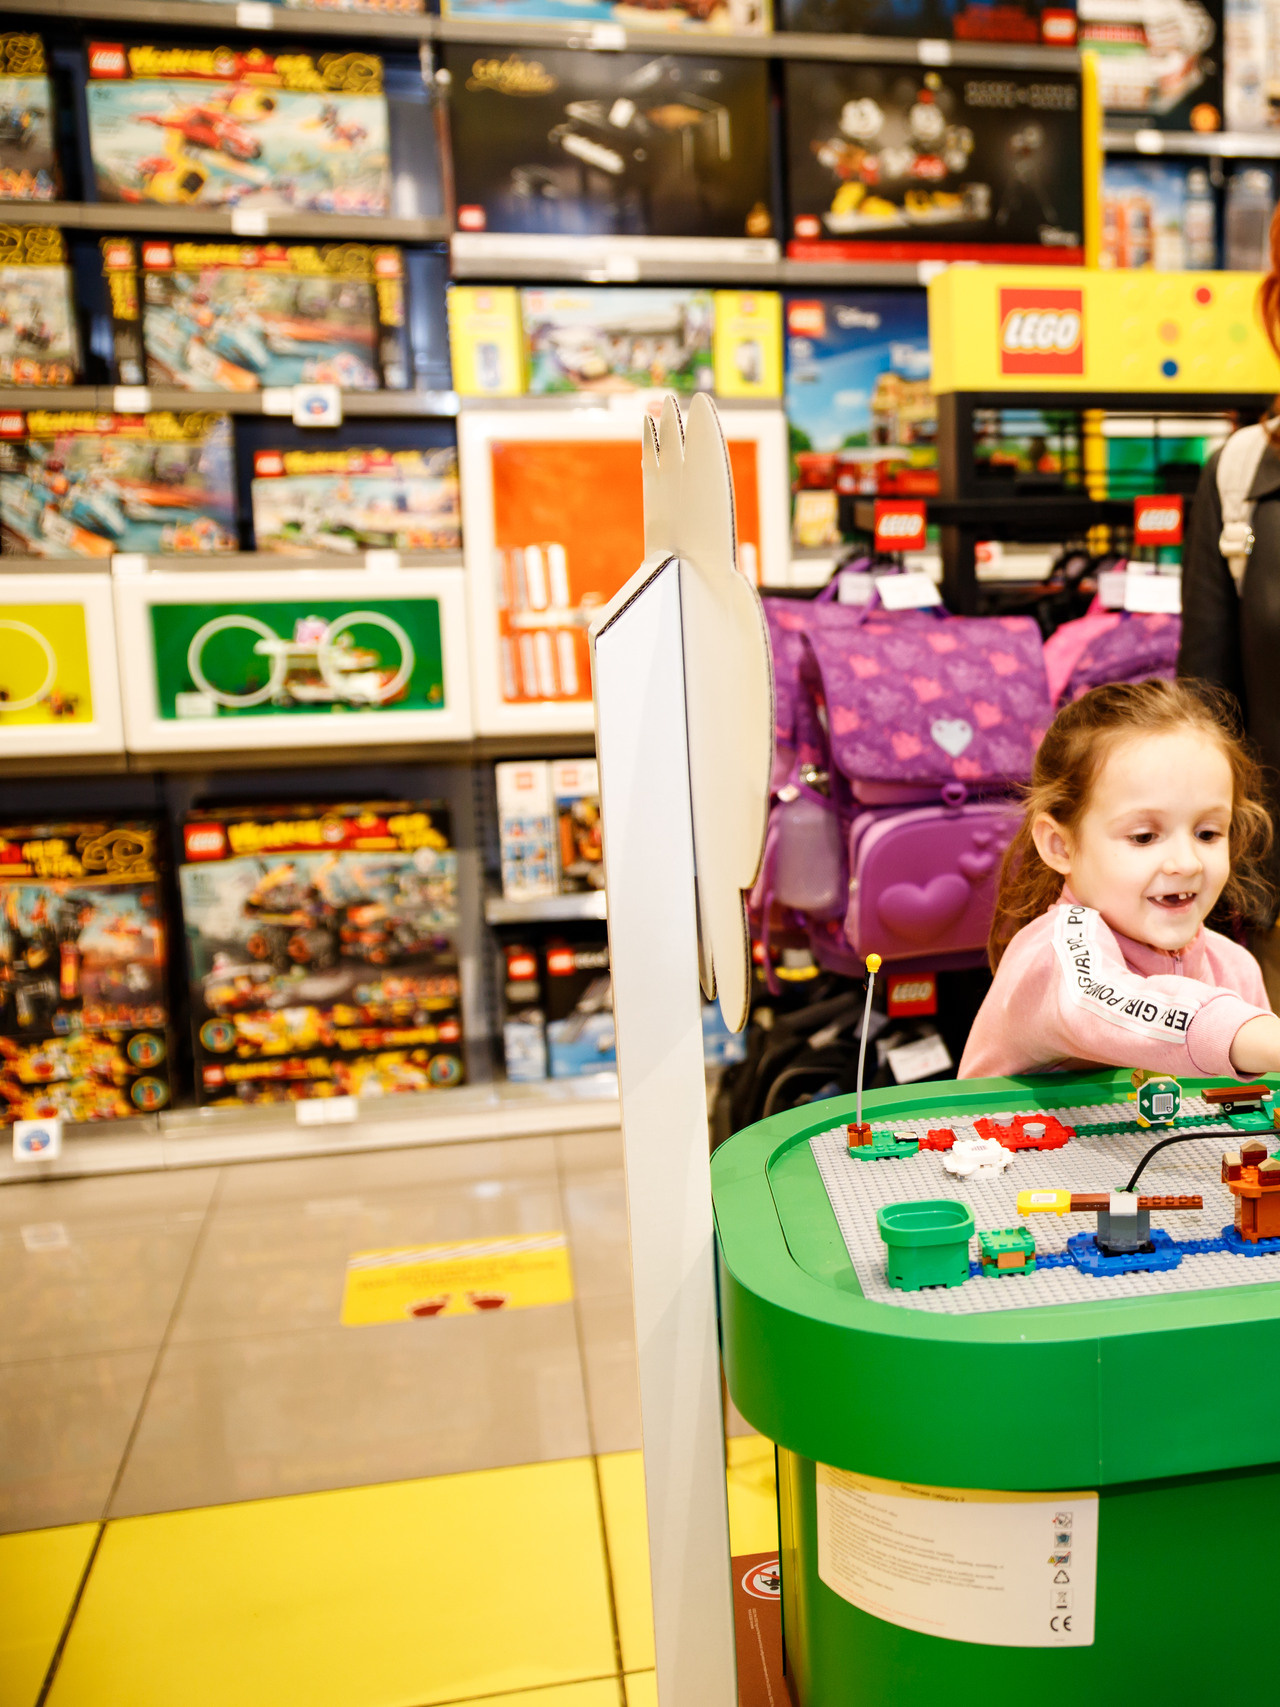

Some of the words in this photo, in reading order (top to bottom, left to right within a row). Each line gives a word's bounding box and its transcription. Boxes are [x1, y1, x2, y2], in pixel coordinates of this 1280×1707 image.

[1002, 310, 1080, 352] LEGO
[877, 514, 924, 537] LEGO
[1137, 508, 1181, 531] LEGO
[891, 982, 933, 1003] LEGO
